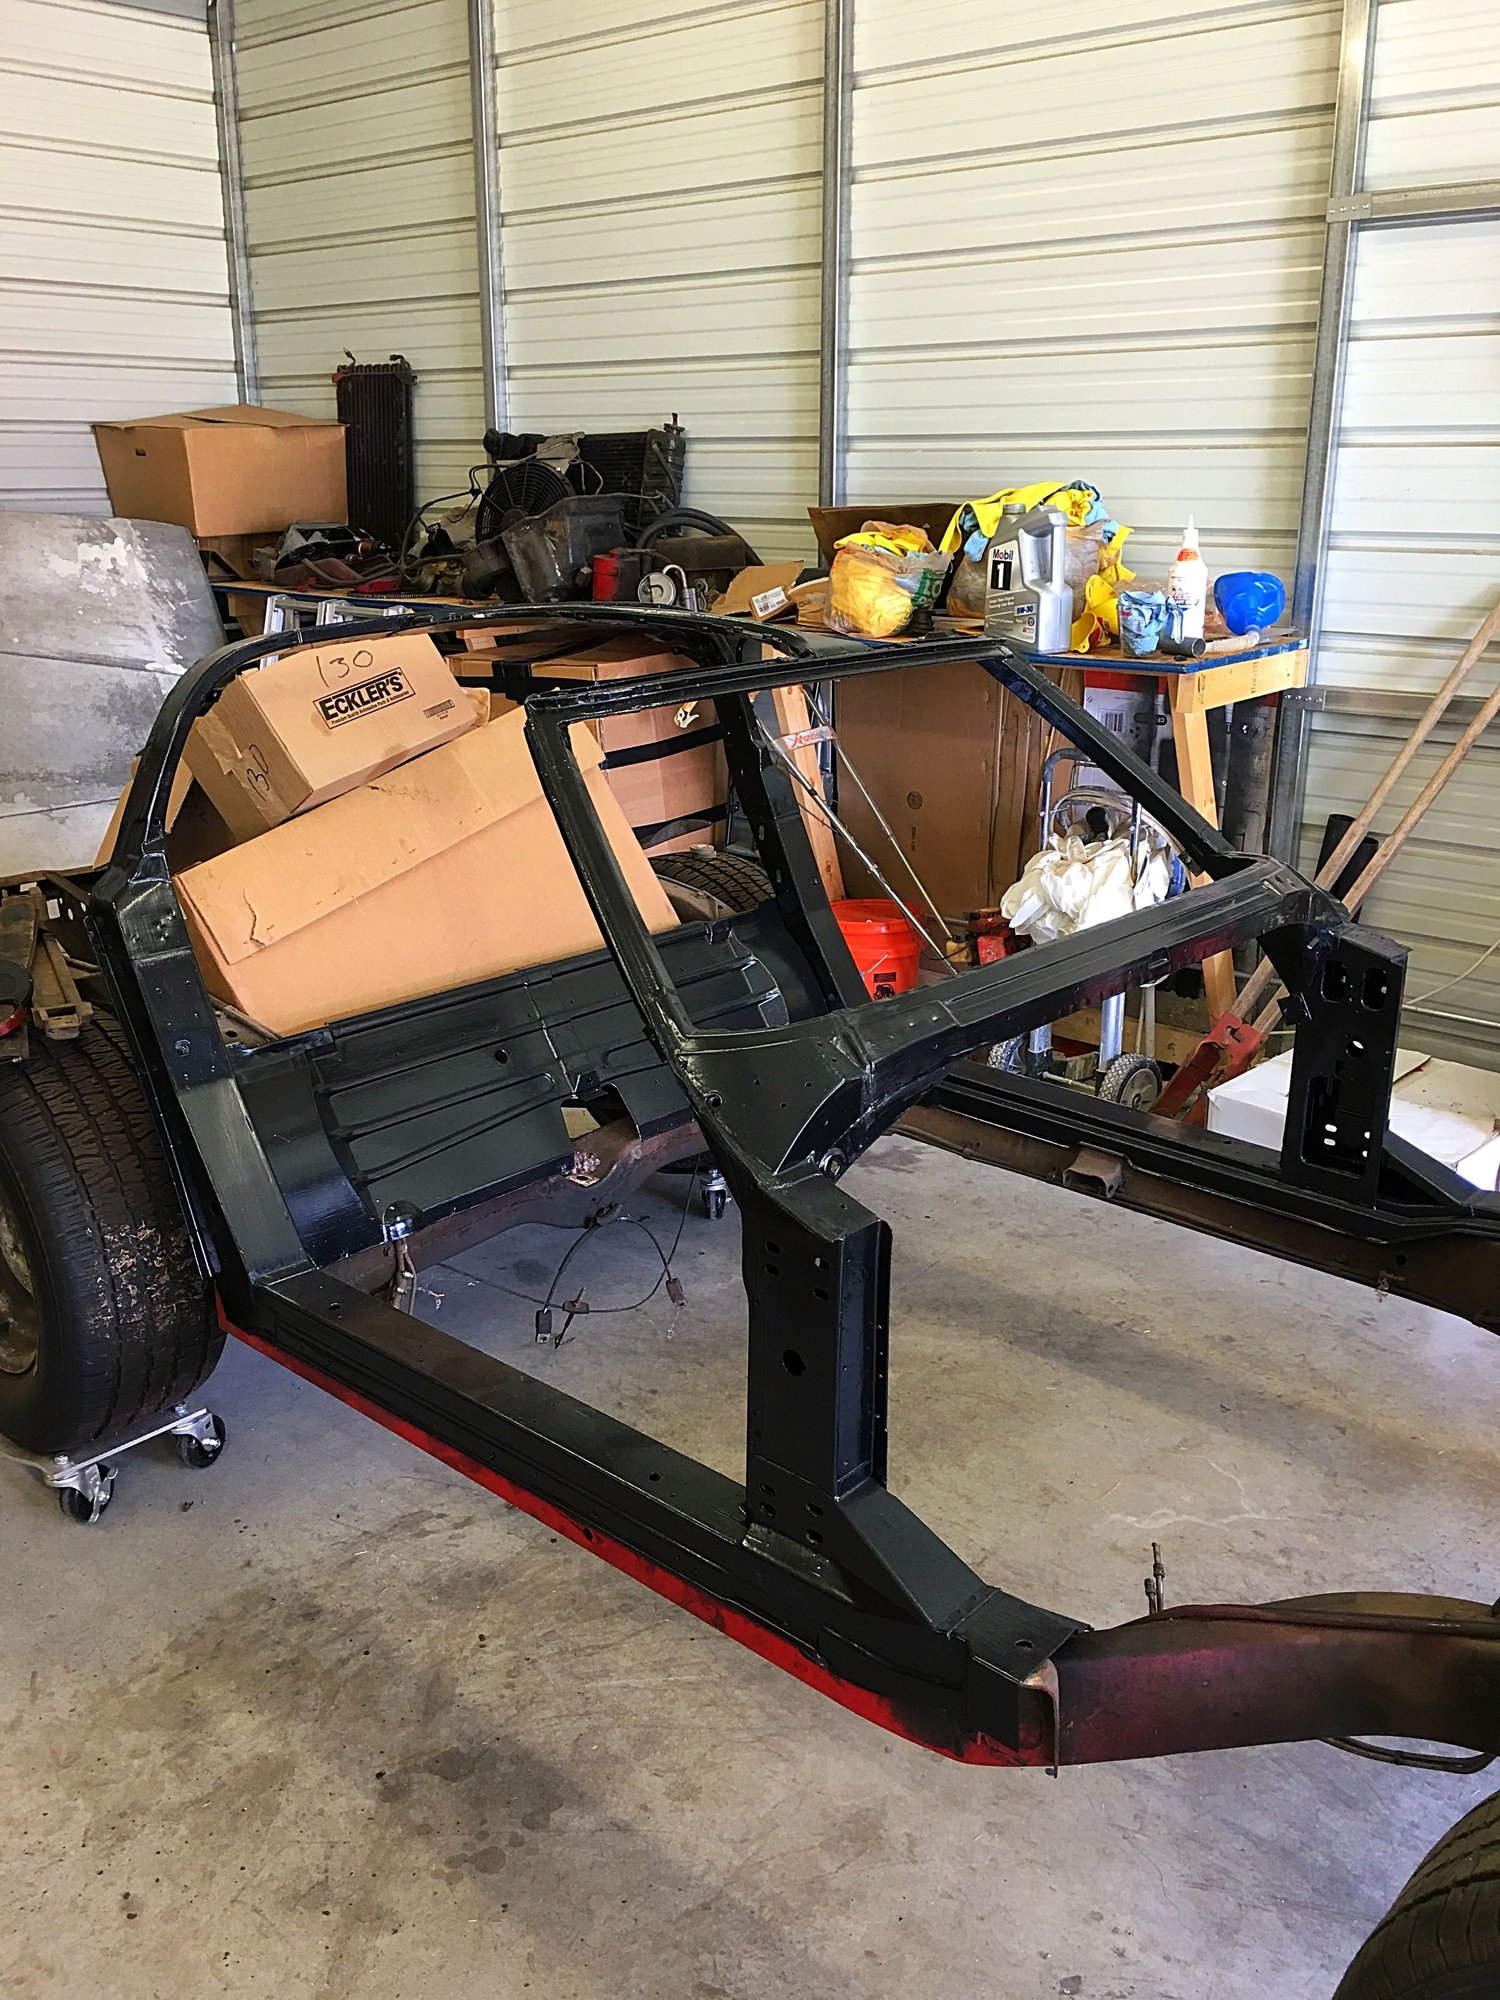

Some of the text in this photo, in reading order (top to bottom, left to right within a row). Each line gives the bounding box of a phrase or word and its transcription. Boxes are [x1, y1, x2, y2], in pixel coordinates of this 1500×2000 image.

[993, 549, 1014, 560] Mobil
[997, 562, 1005, 589] 1
[315, 650, 374, 689] 130
[318, 675, 404, 721] ECKLER'S
[247, 744, 270, 802] 130
